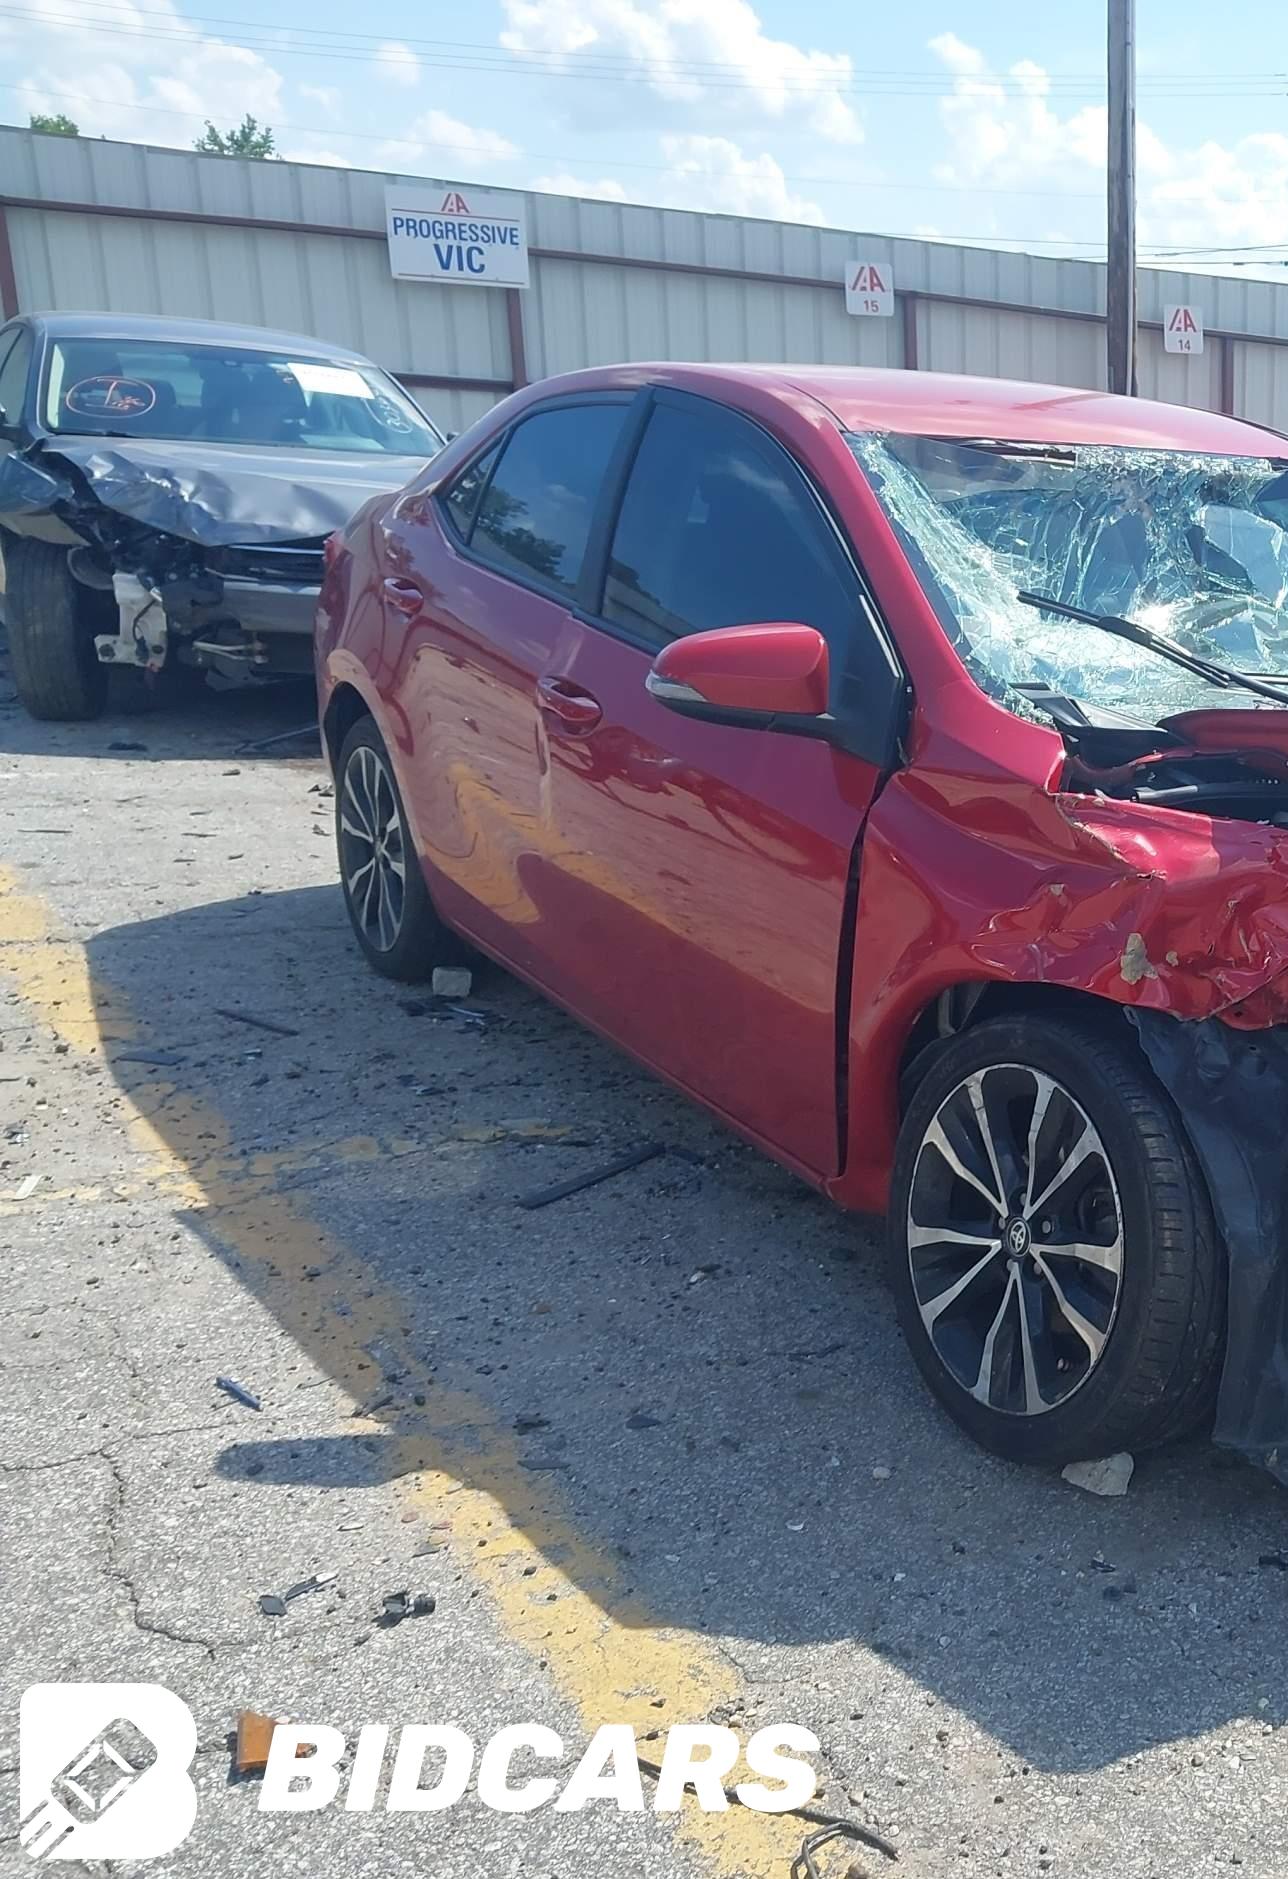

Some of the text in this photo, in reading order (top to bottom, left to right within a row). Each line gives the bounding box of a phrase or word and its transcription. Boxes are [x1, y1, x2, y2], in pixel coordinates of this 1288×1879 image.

[393, 216, 519, 246] PROGRESSIVE
[433, 243, 486, 274] VIC
[864, 299, 879, 313] 15
[1178, 339, 1190, 351] 14
